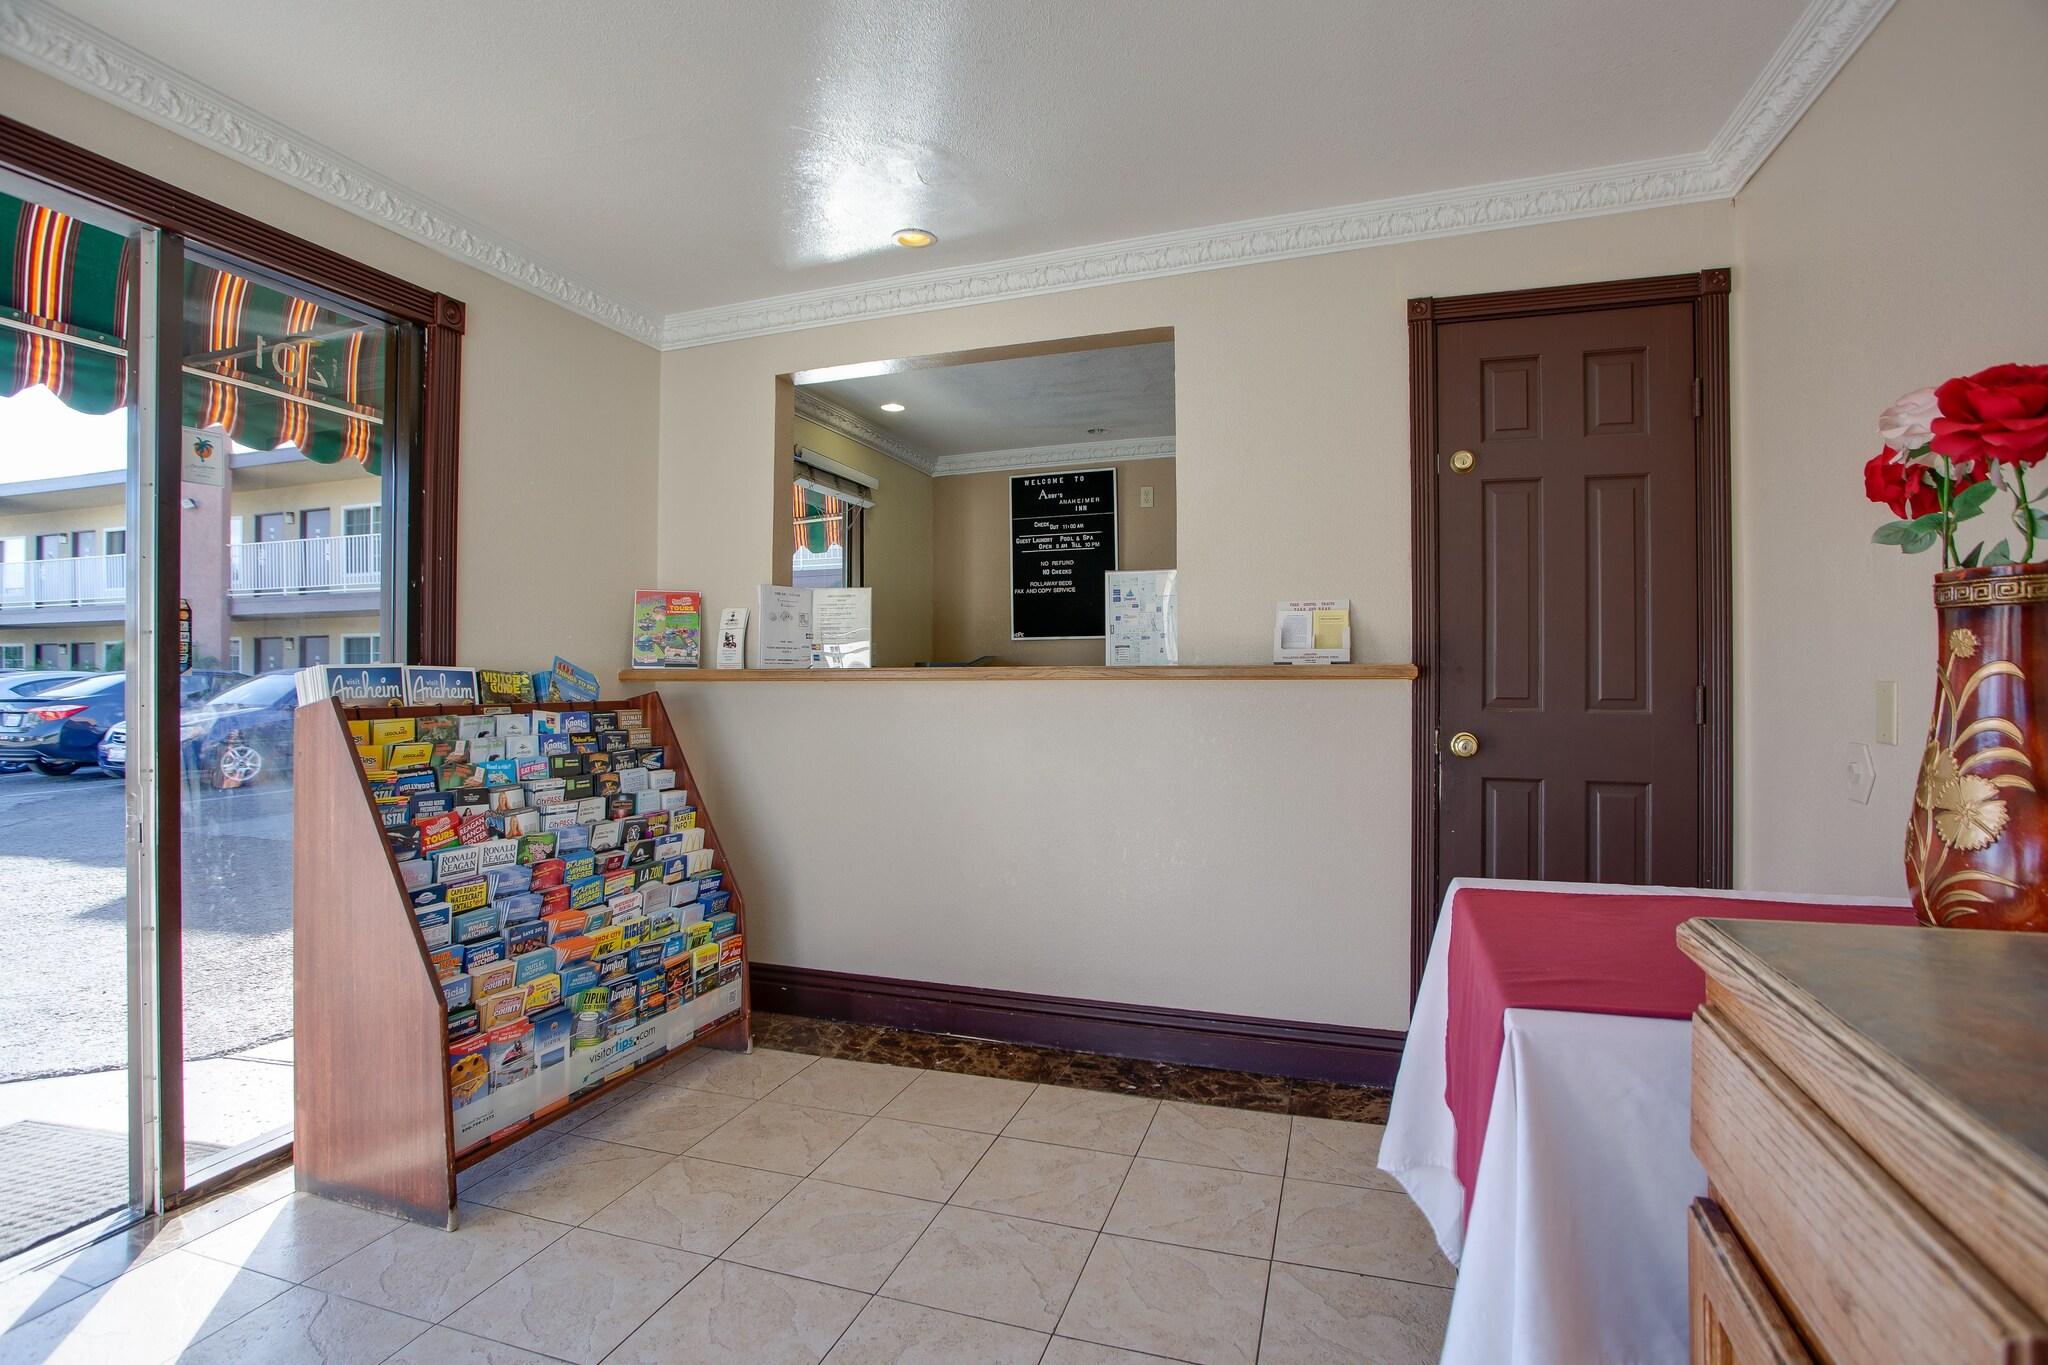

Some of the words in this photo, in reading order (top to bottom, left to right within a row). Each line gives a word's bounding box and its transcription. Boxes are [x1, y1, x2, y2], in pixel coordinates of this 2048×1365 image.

[1024, 477, 1064, 486] WELCOME
[332, 670, 402, 704] Anaheim
[414, 673, 474, 705] Anaheim
[490, 683, 520, 694] GUIDE
[674, 812, 693, 823] TRAVEL
[459, 817, 485, 836] REAGAN
[462, 824, 485, 842] RANCH
[674, 822, 688, 830] INFO
[424, 829, 455, 845] TOURS
[483, 844, 516, 857] RONALD
[441, 851, 476, 866] RONALD
[482, 852, 516, 864] REAGAN
[440, 860, 476, 874] REAGAN
[639, 869, 649, 882] LA
[649, 865, 663, 879] ZOO
[450, 892, 483, 904] WATERCRAFT
[468, 921, 489, 932] WHALE
[461, 926, 494, 942] WATCHING
[473, 949, 494, 960] WHALE
[598, 942, 615, 954] NIKE
[467, 953, 499, 969] WATCHING
[484, 977, 511, 991] COUNTY
[494, 1003, 521, 1017] COUNTY
